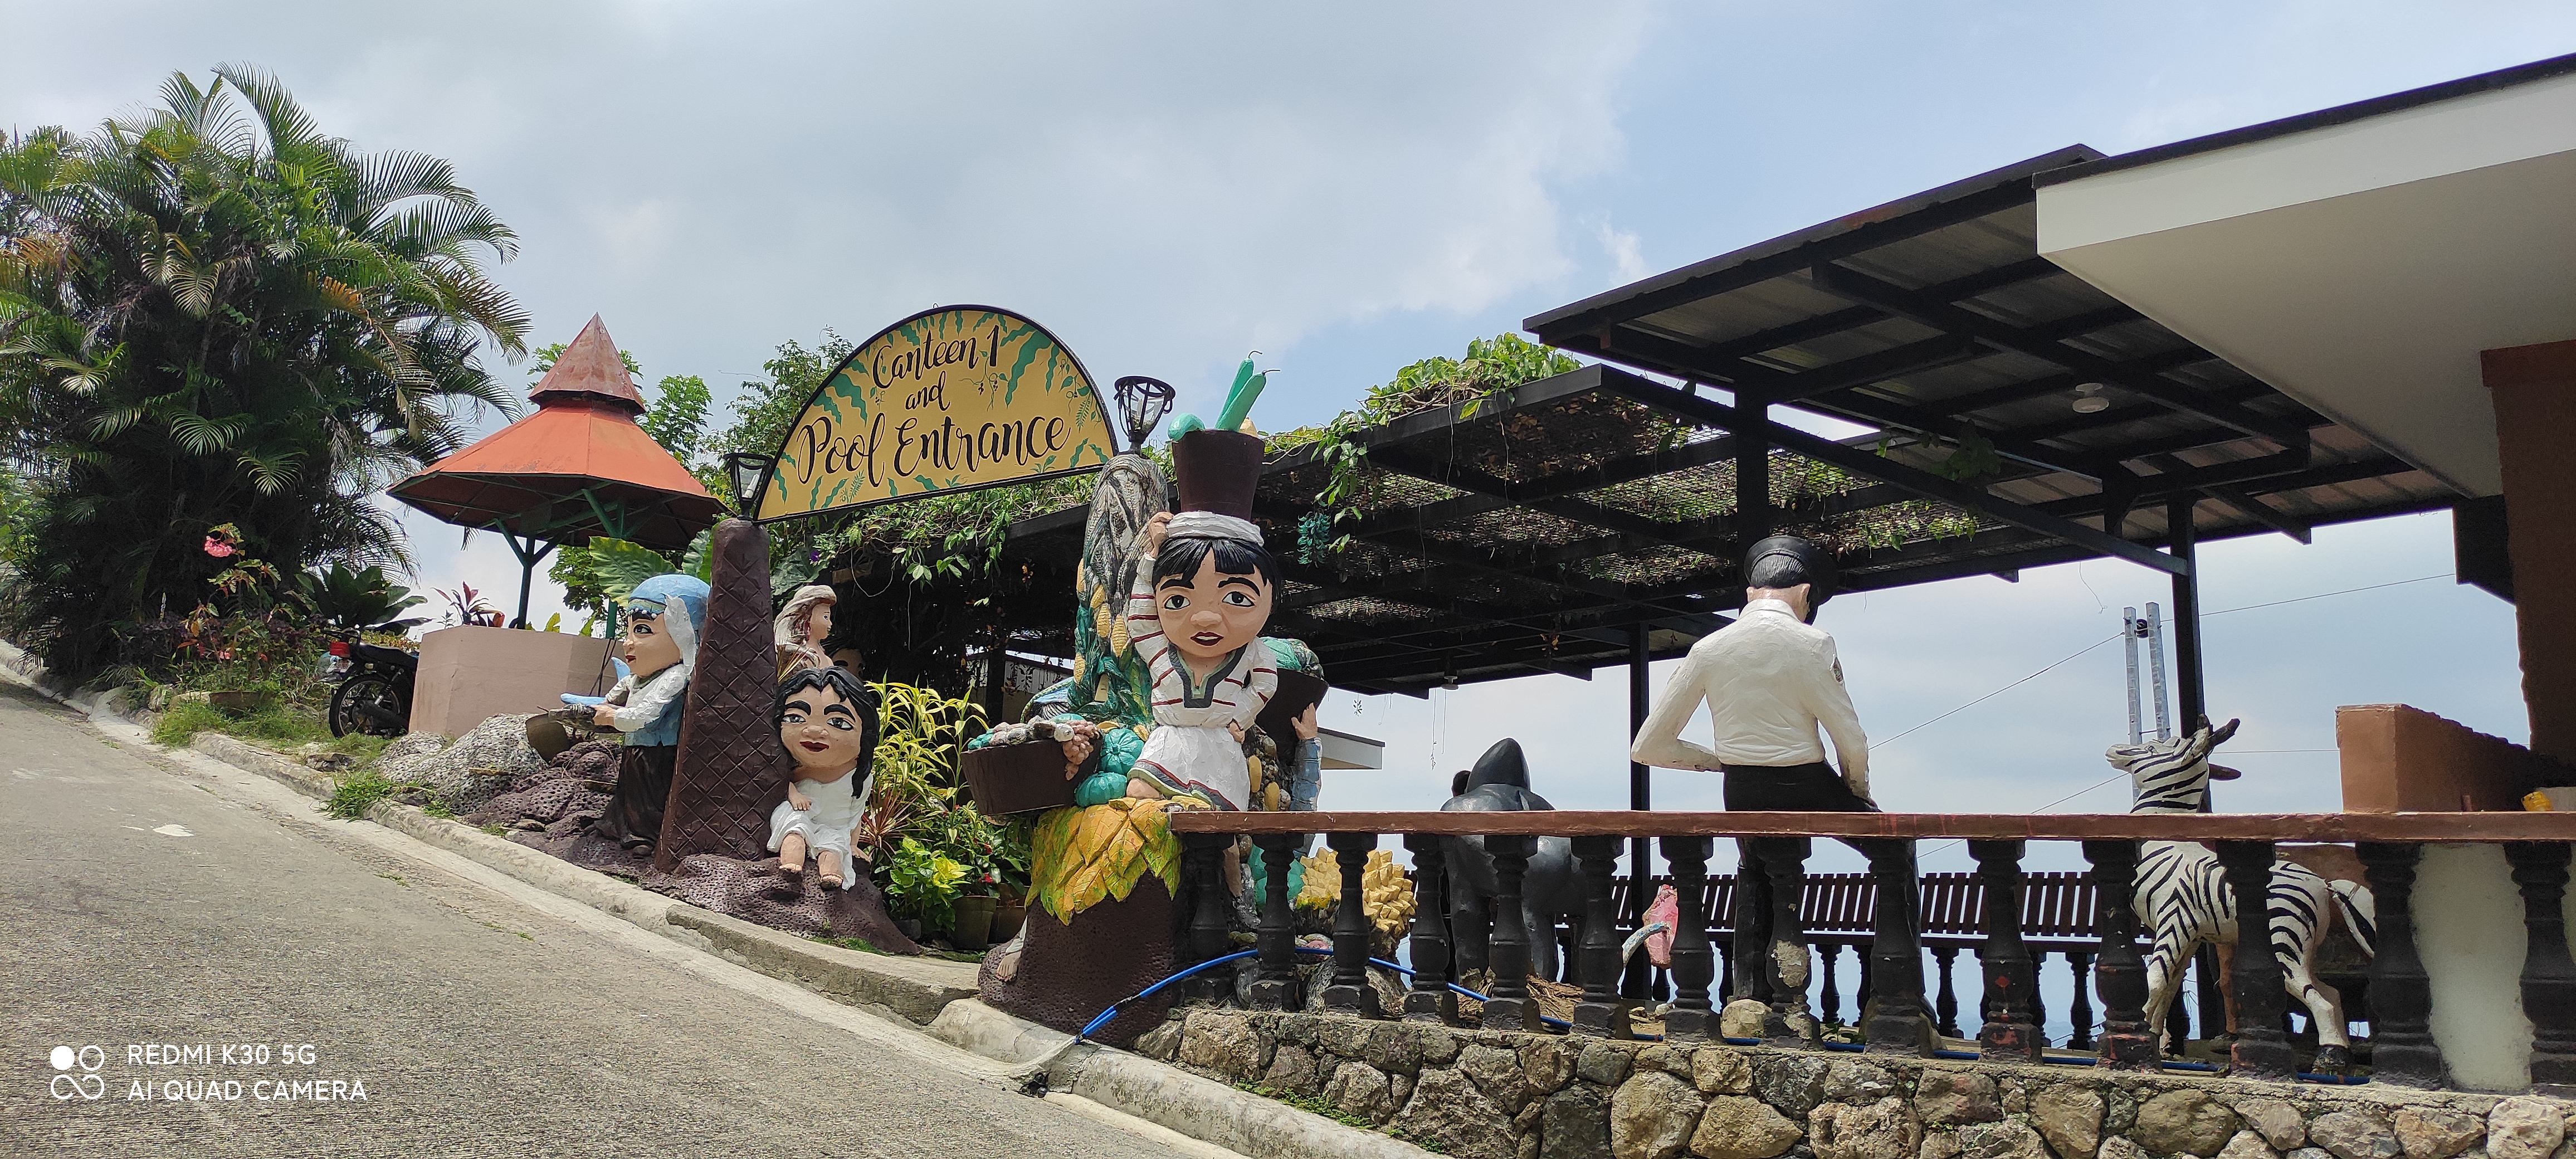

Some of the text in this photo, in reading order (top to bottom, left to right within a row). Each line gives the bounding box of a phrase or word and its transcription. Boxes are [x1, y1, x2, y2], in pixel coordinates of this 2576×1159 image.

[872, 325, 999, 388] Canteen 1
[905, 371, 950, 411] and
[797, 413, 1071, 487] Pool Entrance
